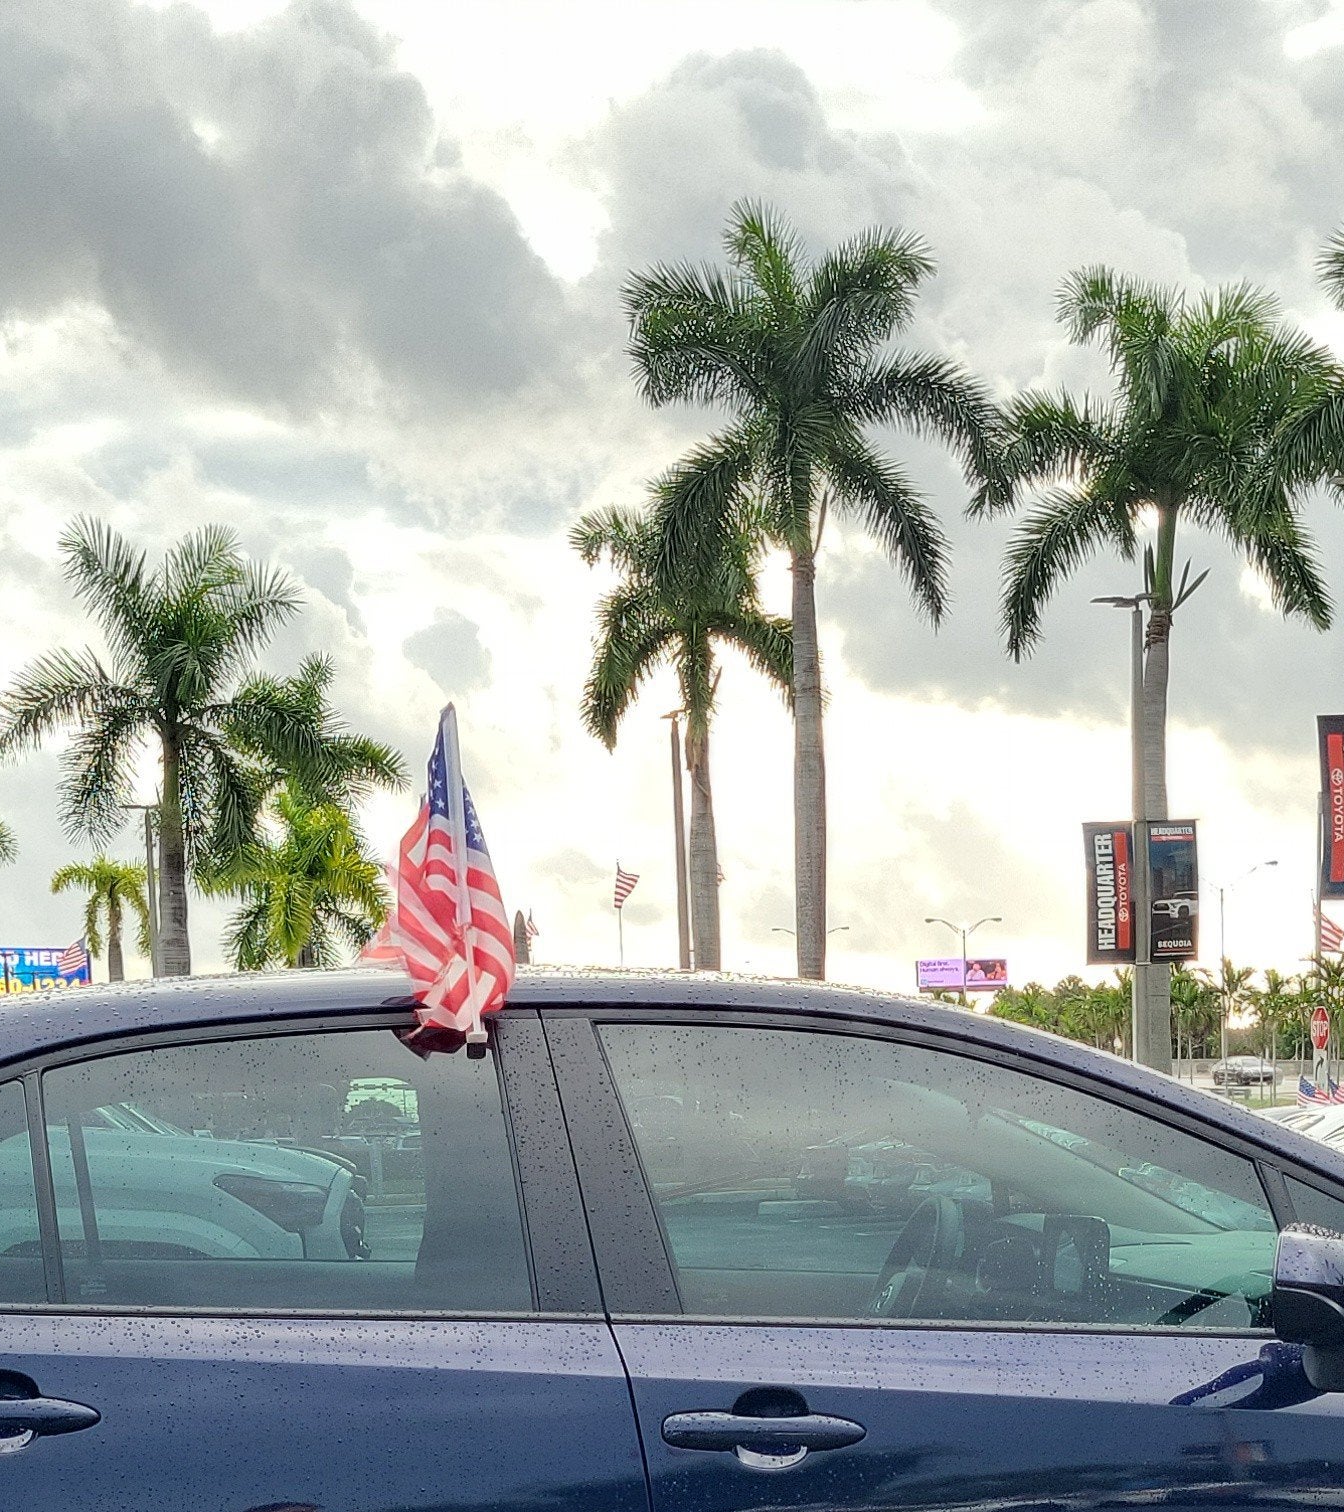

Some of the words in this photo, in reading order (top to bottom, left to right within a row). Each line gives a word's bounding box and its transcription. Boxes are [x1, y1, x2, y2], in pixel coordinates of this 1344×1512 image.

[1333, 787, 1344, 842] TOYOTA
[1094, 833, 1118, 950] HEADQUARTER
[1118, 863, 1128, 909] TOYOTA
[1157, 940, 1192, 949] SEQUOIA
[1312, 1020, 1329, 1037] STOP
